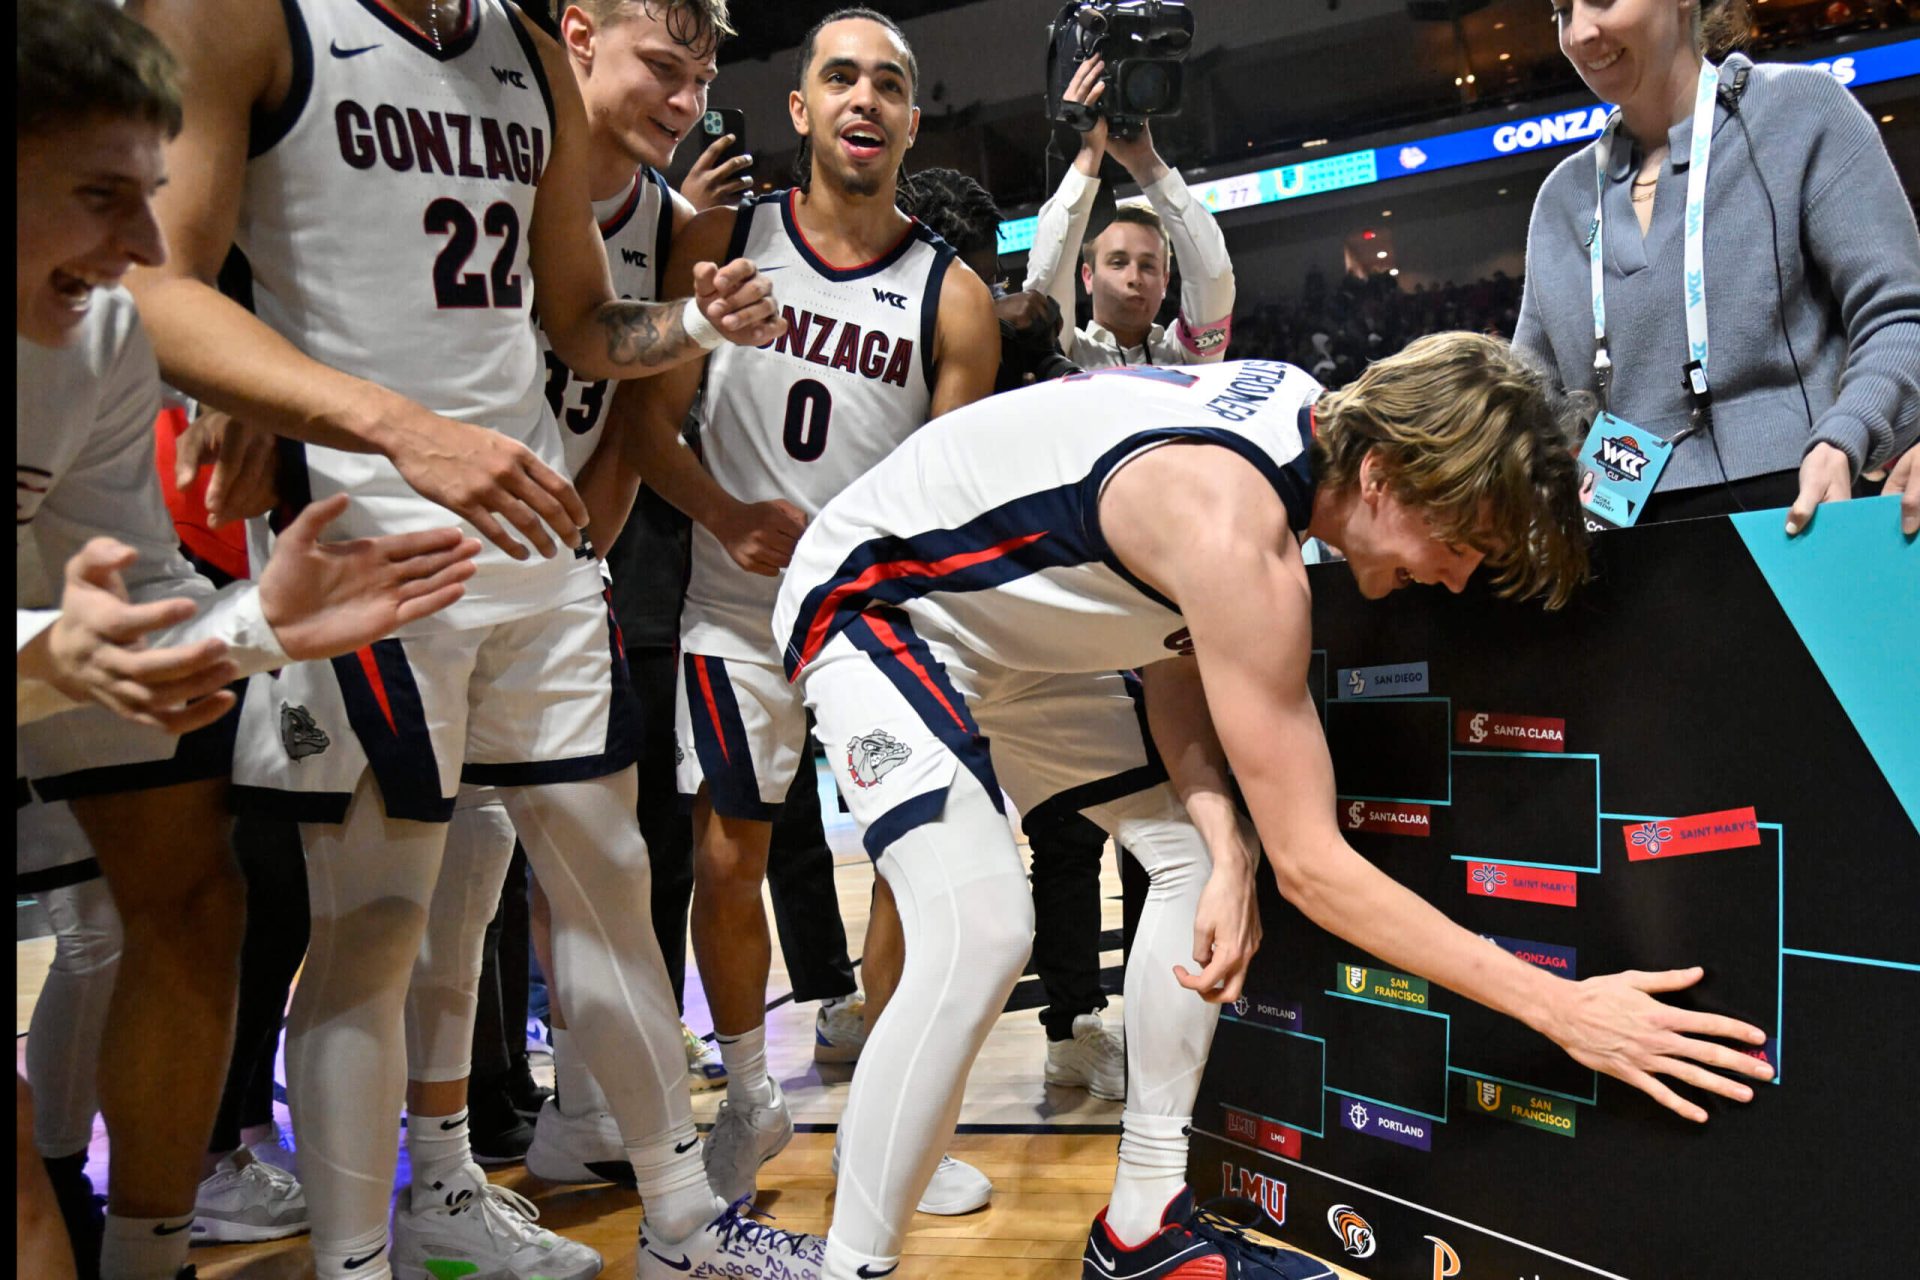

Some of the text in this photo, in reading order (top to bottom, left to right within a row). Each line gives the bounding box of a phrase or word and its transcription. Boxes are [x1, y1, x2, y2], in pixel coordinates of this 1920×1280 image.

[1229, 187, 1249, 205] 77
[423, 196, 523, 310] 22
[872, 287, 909, 311] WCC
[1687, 269, 1702, 309] WCC
[756, 304, 914, 388] NZAGA
[782, 377, 833, 463] 0
[1603, 439, 1647, 479] WCC
[1374, 674, 1393, 686] SAN
[1394, 671, 1423, 684] DIEGO
[1494, 724, 1526, 738] SANTA
[1527, 727, 1564, 741] CLARA
[1369, 811, 1398, 823] SANTA
[1398, 813, 1429, 825] CLARA
[1680, 826, 1712, 840] SAINT
[1714, 819, 1757, 834] MARY'S
[1512, 878, 1539, 889] SAINT
[1541, 881, 1576, 894] MARY'S
[1514, 950, 1568, 970] GONZAGA
[1390, 976, 1409, 990] SAN
[1374, 985, 1426, 1005] FRANCISCO
[1257, 1003, 1297, 1021] PORTLAND
[1530, 1097, 1552, 1112] SAN
[1511, 1104, 1571, 1130] FRANCISCO
[1377, 1116, 1425, 1139] PORTLAND
[1270, 1132, 1286, 1144] LMU
[1222, 1161, 1288, 1227] LMU
